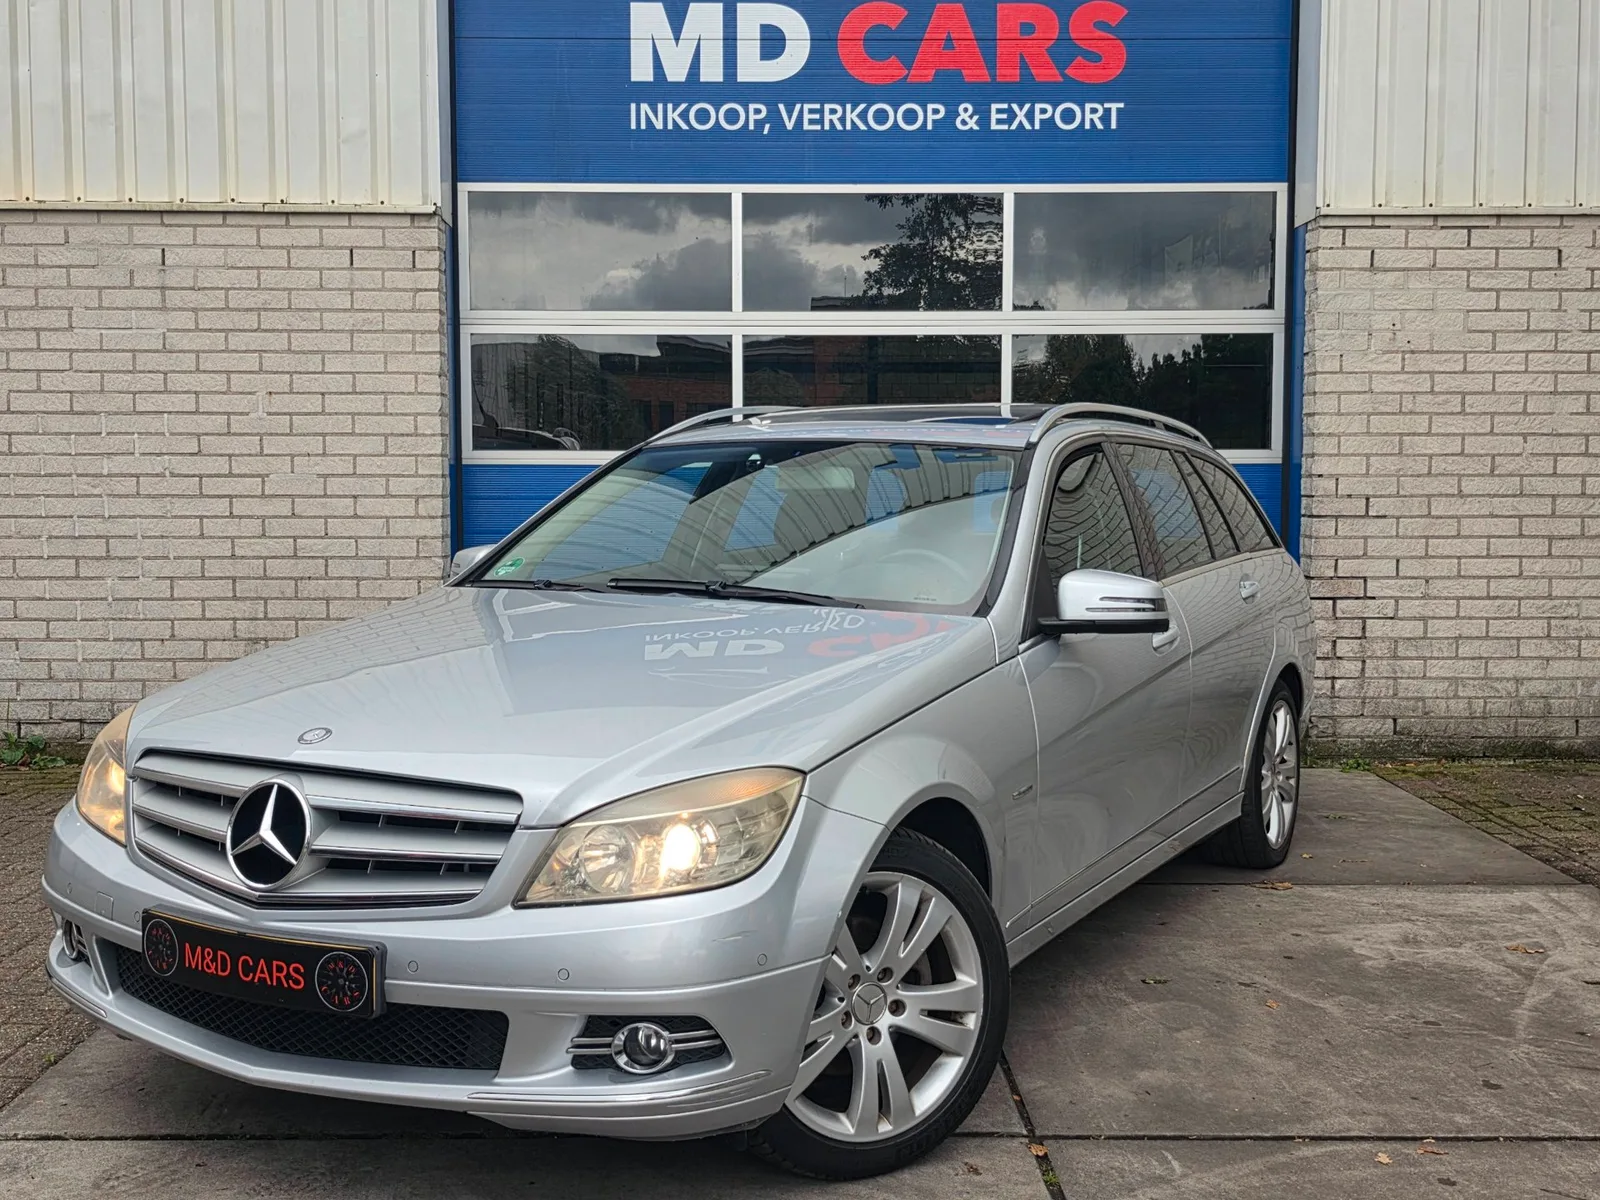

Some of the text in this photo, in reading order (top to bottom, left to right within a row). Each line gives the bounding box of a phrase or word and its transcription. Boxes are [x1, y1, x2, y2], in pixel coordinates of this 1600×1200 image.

[630, 0, 1129, 84] MD CARS
[630, 102, 1125, 135] INKOOP, VERKOOP & EXPORT
[184, 942, 231, 977] M&D
[237, 955, 305, 990] CARS
